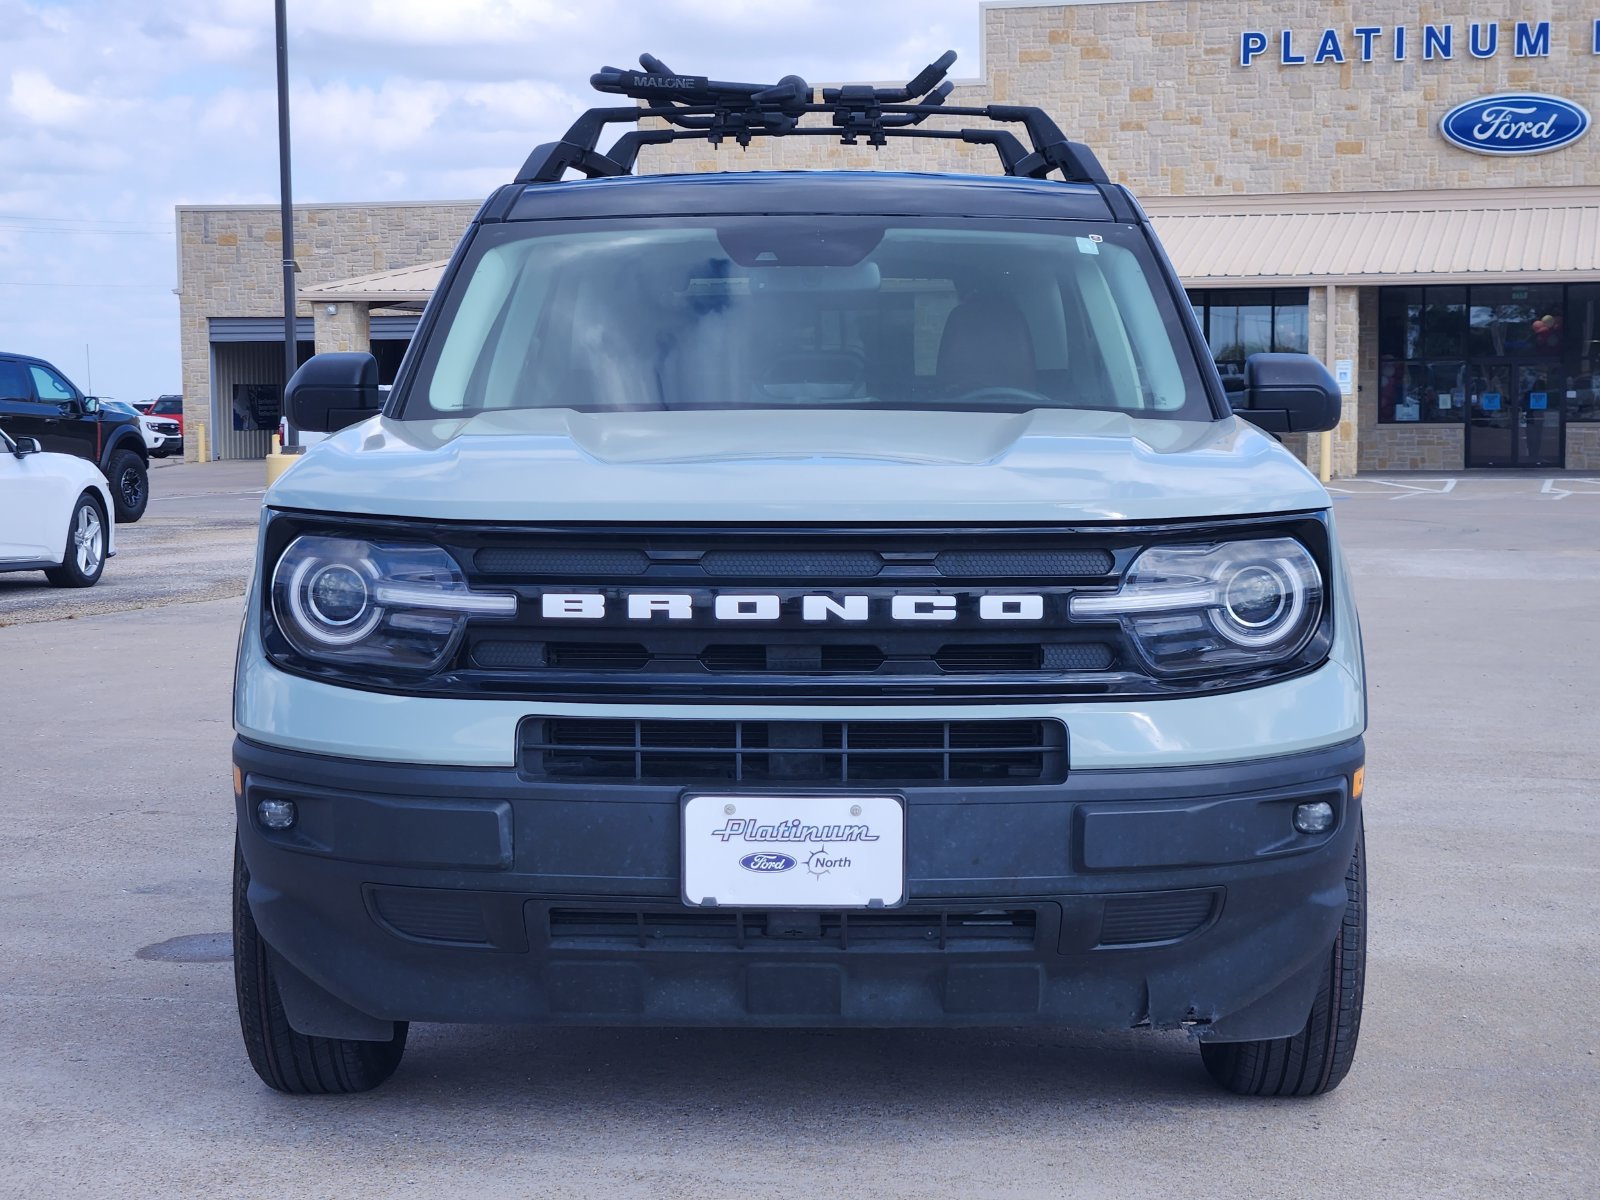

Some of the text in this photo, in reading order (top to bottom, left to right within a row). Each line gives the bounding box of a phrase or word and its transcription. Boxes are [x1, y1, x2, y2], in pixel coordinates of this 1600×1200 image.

[1240, 21, 1550, 67] PLATINUM
[633, 76, 695, 89] MALONE
[1473, 106, 1557, 140] Ford
[542, 594, 1044, 620] BRONCO
[712, 818, 880, 842] Platinum
[750, 855, 851, 870] Ford North
